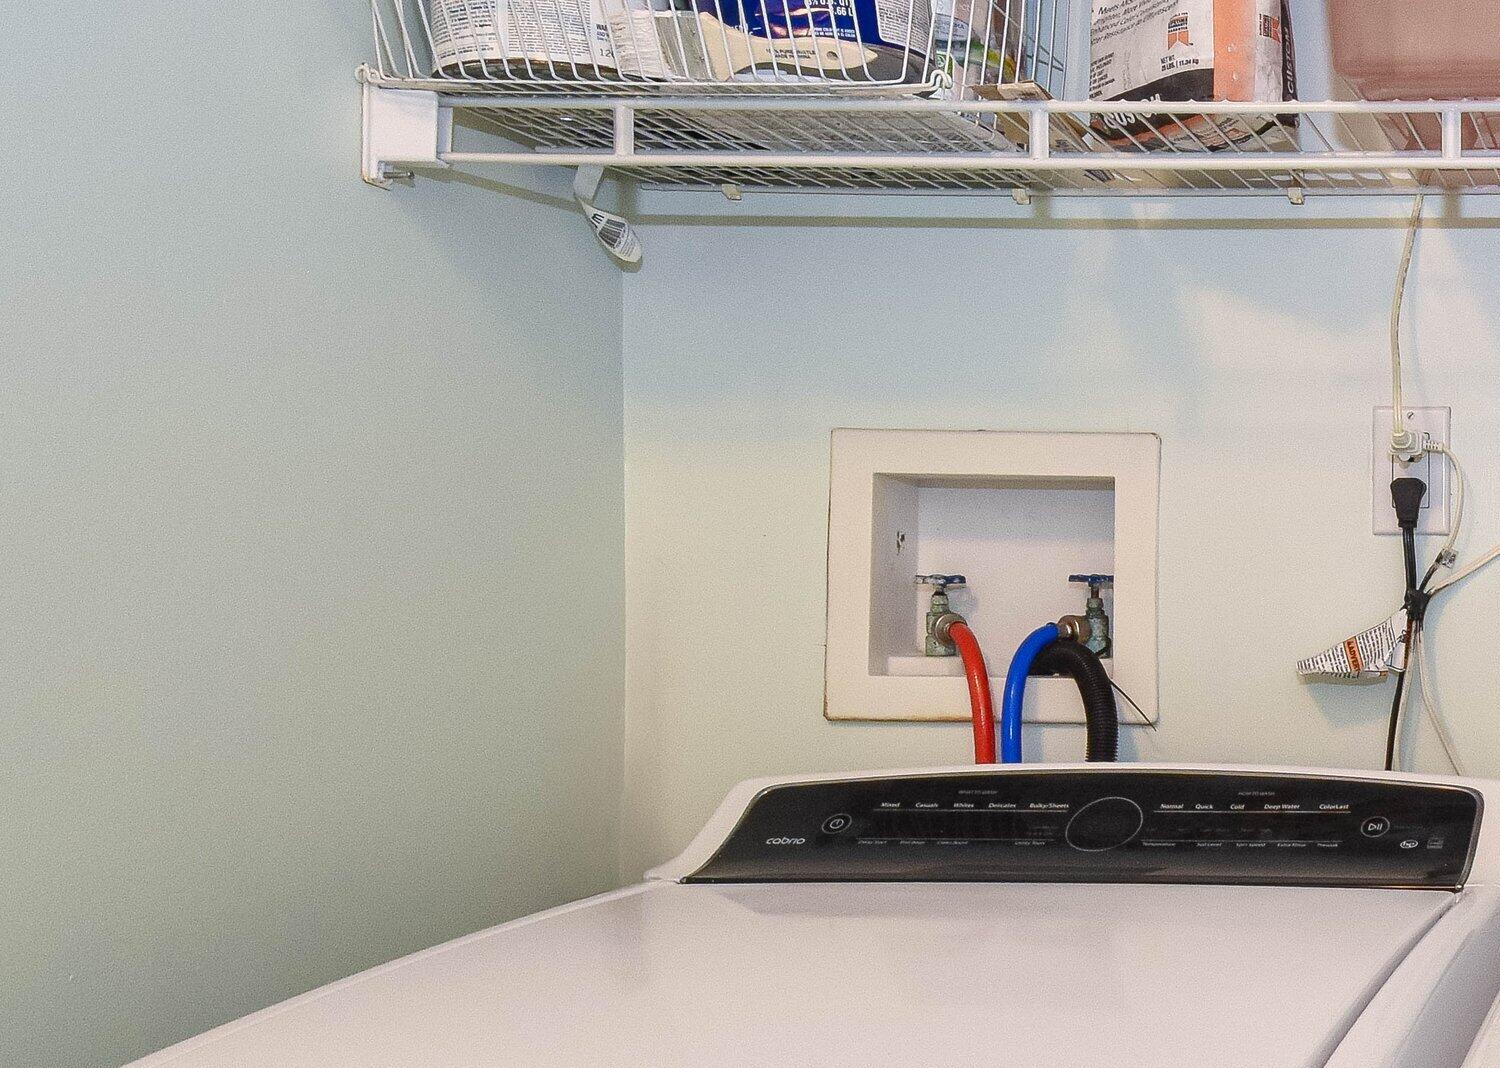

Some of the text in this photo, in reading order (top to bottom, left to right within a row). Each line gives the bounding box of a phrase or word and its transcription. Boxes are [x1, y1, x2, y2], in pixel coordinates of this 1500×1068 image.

[915, 801, 939, 809] Casuals
[1264, 803, 1281, 811] Deep
[766, 836, 805, 845] cabrio
